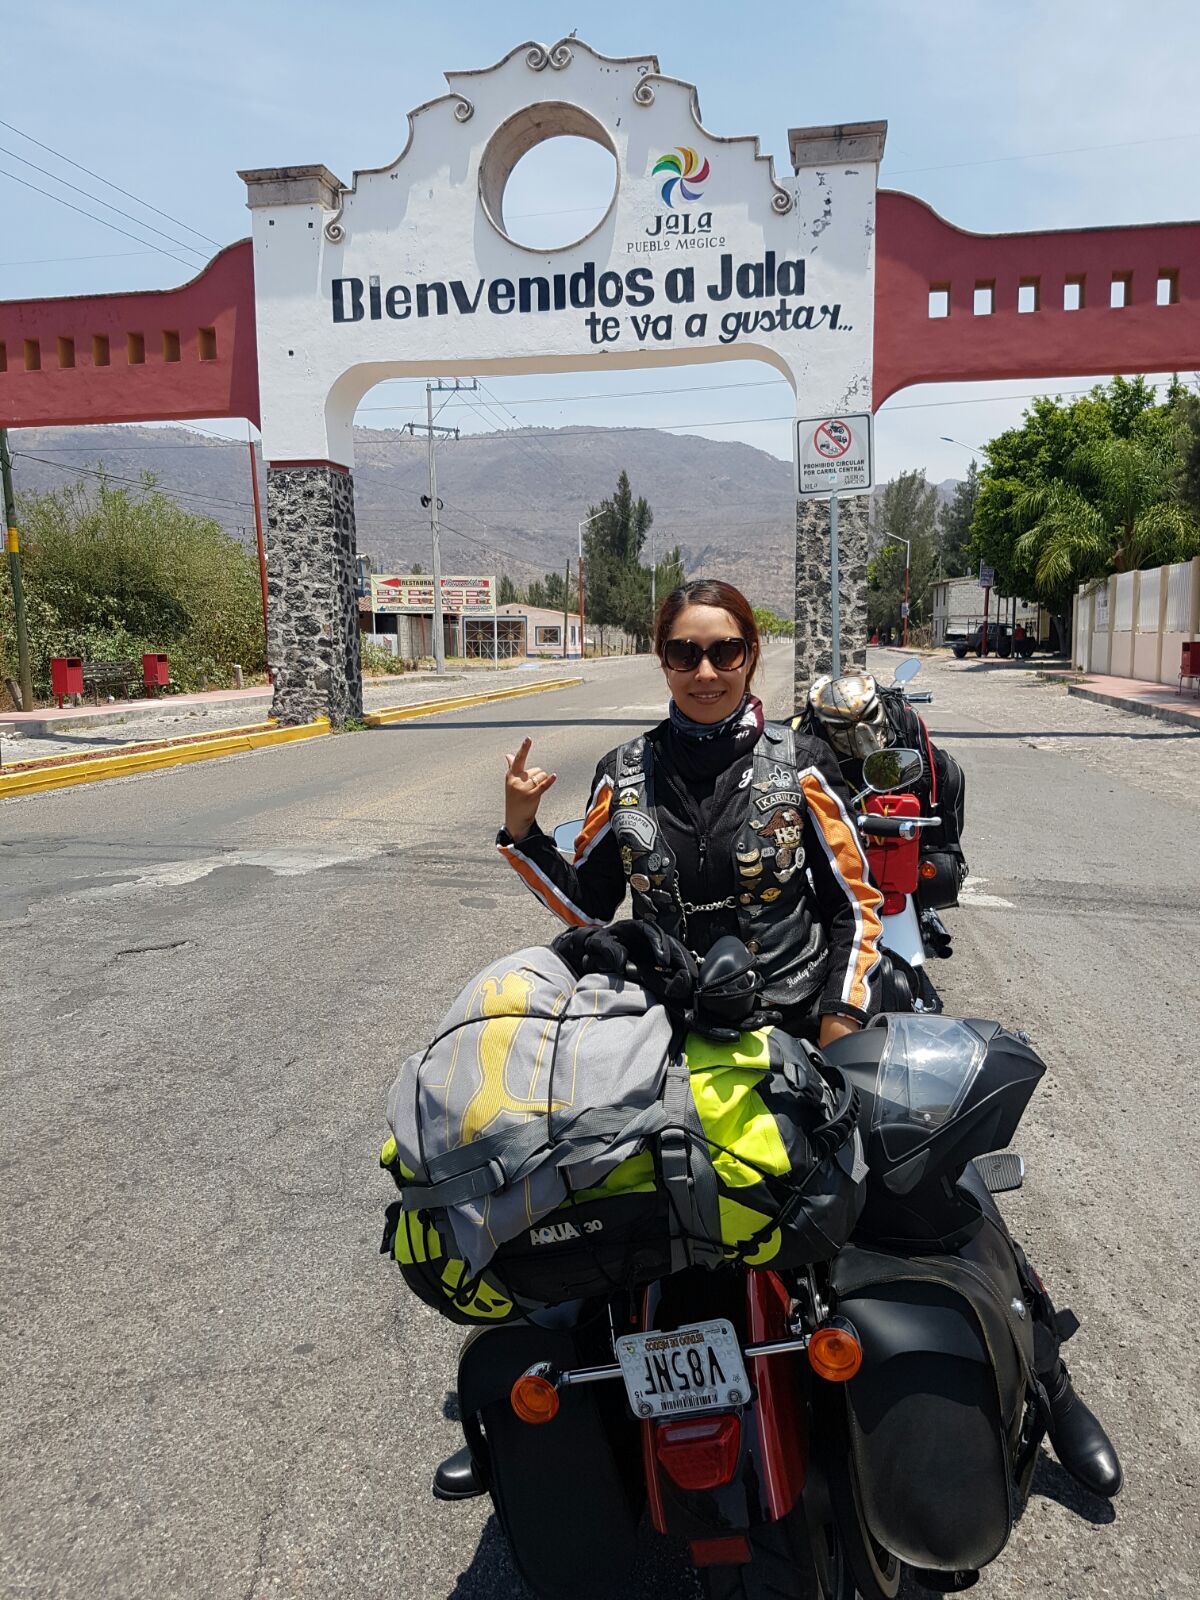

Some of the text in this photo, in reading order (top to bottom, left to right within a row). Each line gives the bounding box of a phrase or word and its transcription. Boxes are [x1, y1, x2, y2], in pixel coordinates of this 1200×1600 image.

[331, 250, 806, 323] Bienvenidos a Jala
[584, 311, 621, 344] te
[630, 314, 673, 341] va
[684, 313, 708, 338] a
[761, 793, 798, 808] KARINA
[627, 813, 649, 829] CHAPTER
[529, 1219, 603, 1246] AQUA 30
[678, 1332, 705, 1346] ESTADO
[644, 1345, 726, 1396] V85NF
